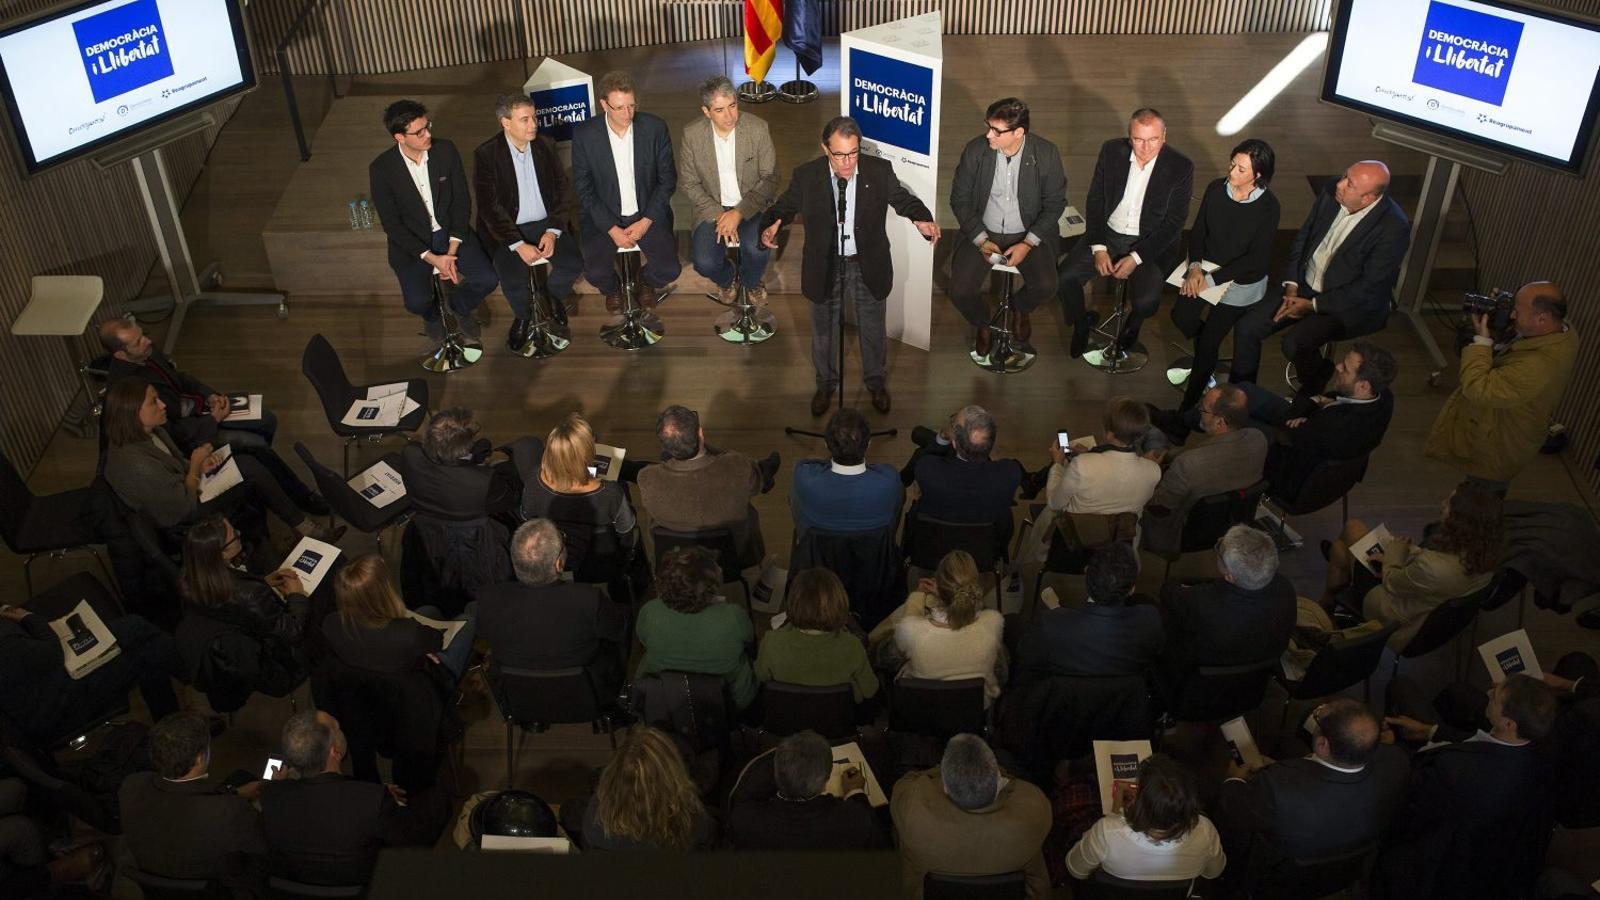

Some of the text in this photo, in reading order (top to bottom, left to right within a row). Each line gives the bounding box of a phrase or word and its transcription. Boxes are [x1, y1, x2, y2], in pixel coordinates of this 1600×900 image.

[85, 24, 158, 57] DEMOCRÀCIA
[92, 35, 160, 76] i Llibertat
[1428, 29, 1509, 59] DEMOCRÀCIA
[1425, 44, 1505, 79] i Llibertat
[854, 78, 926, 106] DEMOCRÀCIA
[862, 93, 924, 126] Llibertat
